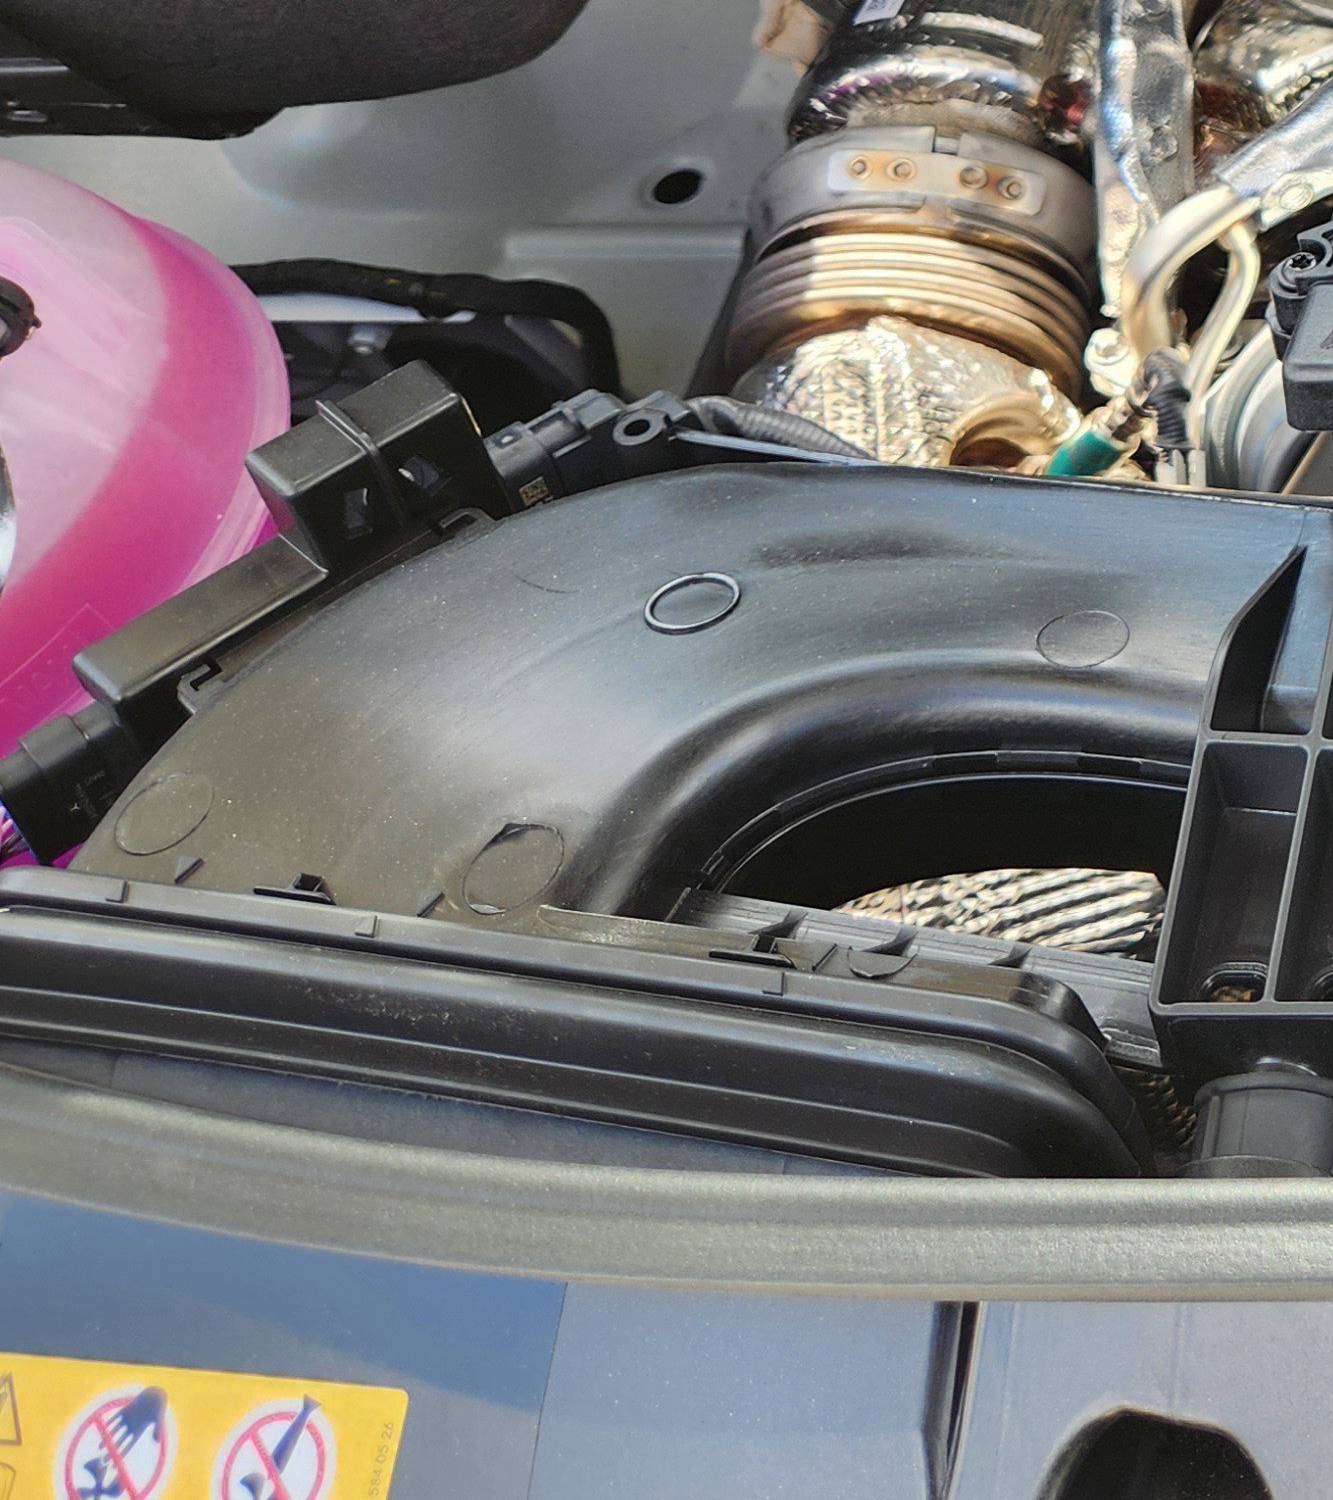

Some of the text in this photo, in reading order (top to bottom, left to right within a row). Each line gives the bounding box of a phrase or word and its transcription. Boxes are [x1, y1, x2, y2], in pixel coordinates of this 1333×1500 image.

[369, 1422, 394, 1497] 584 05 26
